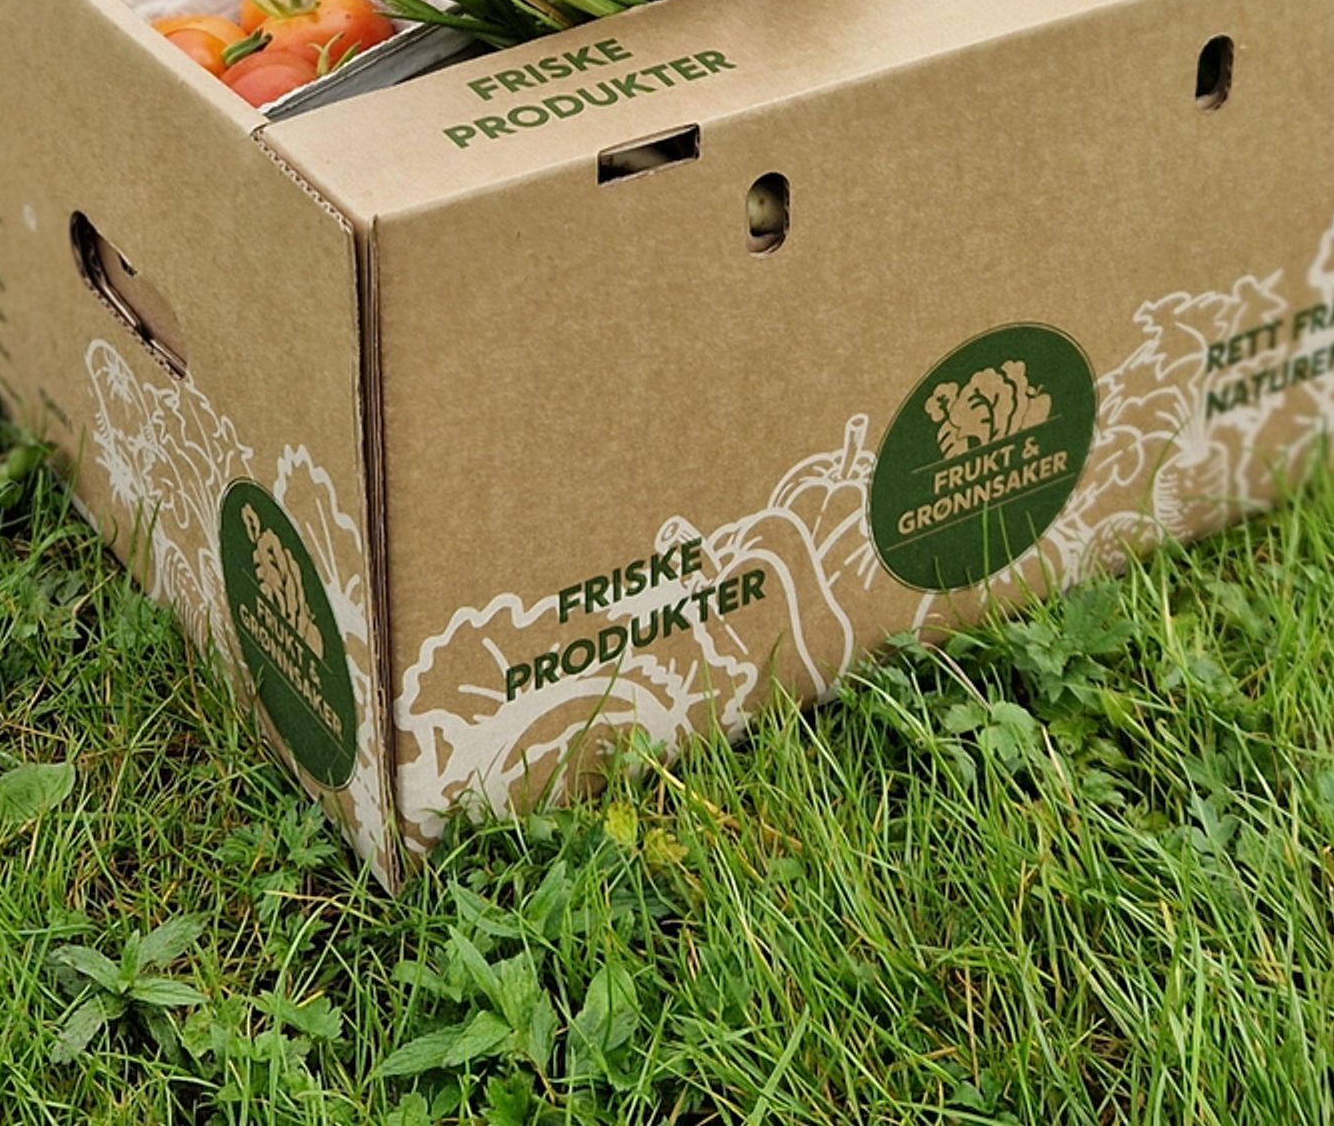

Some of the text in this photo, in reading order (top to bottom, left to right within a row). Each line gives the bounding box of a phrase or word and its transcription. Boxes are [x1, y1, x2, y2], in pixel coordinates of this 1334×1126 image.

[443, 49, 737, 149] PRODUKTER
[468, 38, 633, 101] FRISKE
[1206, 320, 1283, 373] RETT
[898, 451, 1067, 534] GRØNNSAKER
[934, 436, 1039, 494] FRUKT &
[558, 537, 703, 623] FRISKE
[506, 569, 766, 701] PRODUKTER
